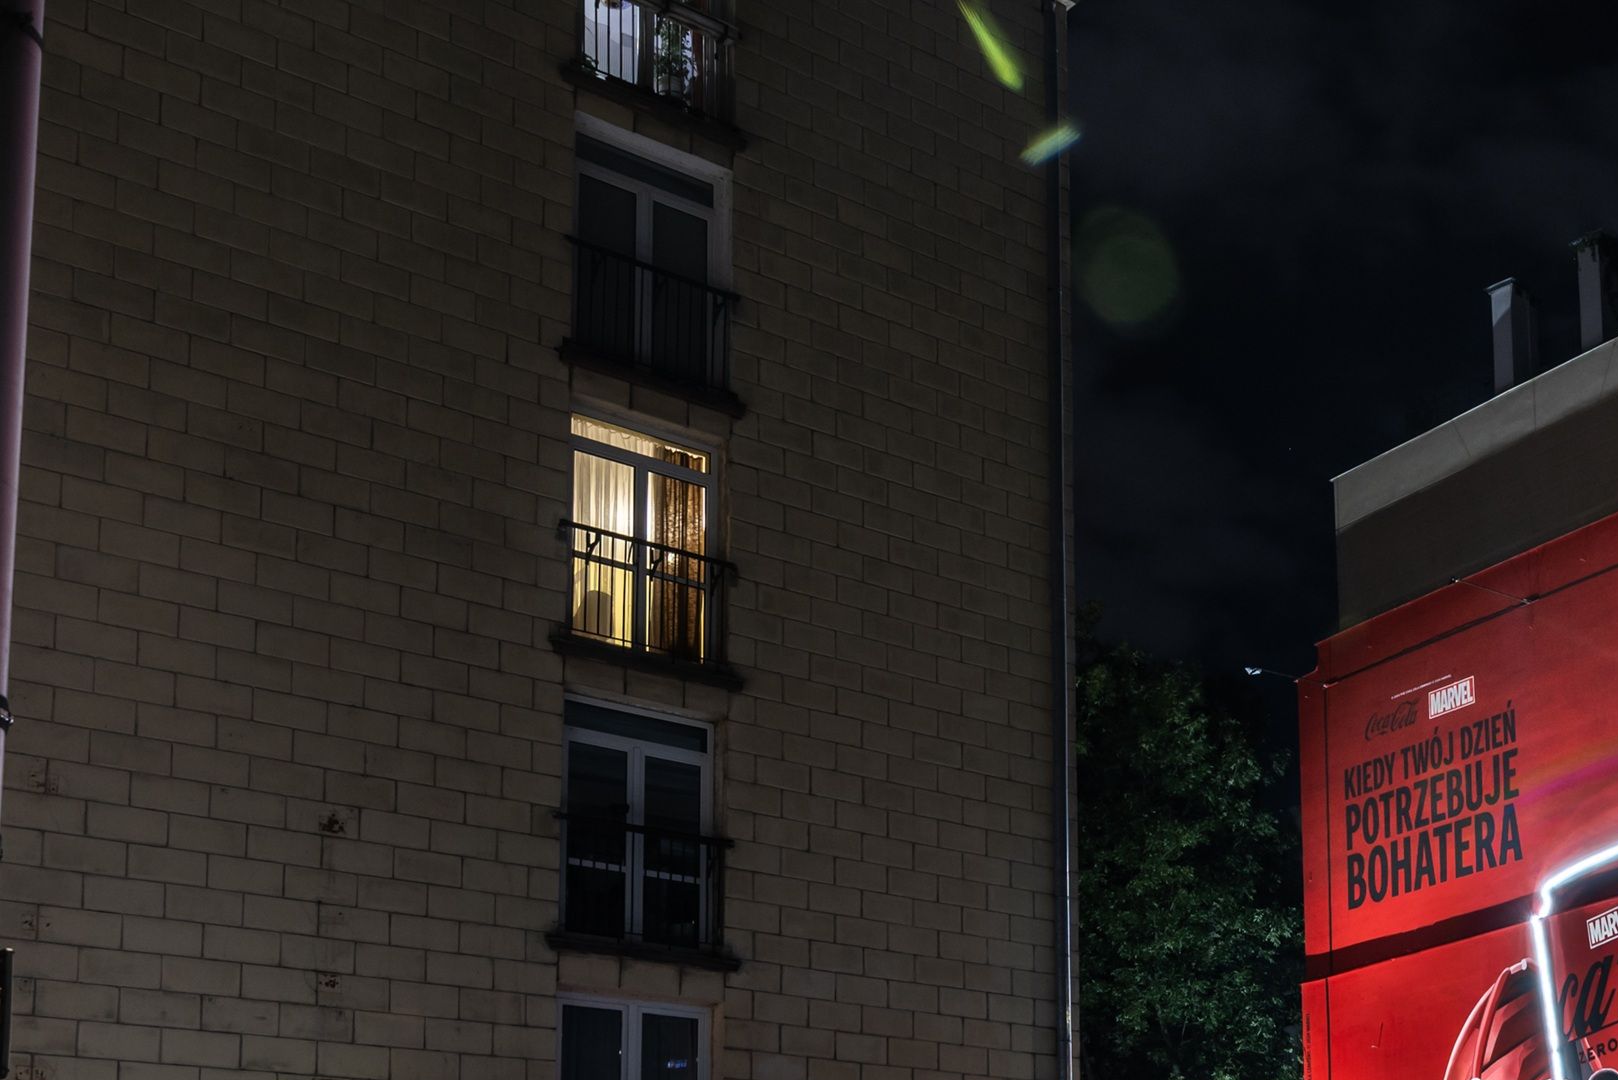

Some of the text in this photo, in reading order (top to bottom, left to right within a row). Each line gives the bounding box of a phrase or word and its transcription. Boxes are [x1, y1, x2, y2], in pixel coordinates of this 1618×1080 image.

[1430, 679, 1474, 716] MARVEL
[1343, 699, 1517, 801] KIEDY TWÓJ DZIEŃ
[1345, 747, 1520, 851] POTRZEBUJE
[1347, 803, 1524, 911] BOHATERA
[1578, 1038, 1618, 1065] ZERO
